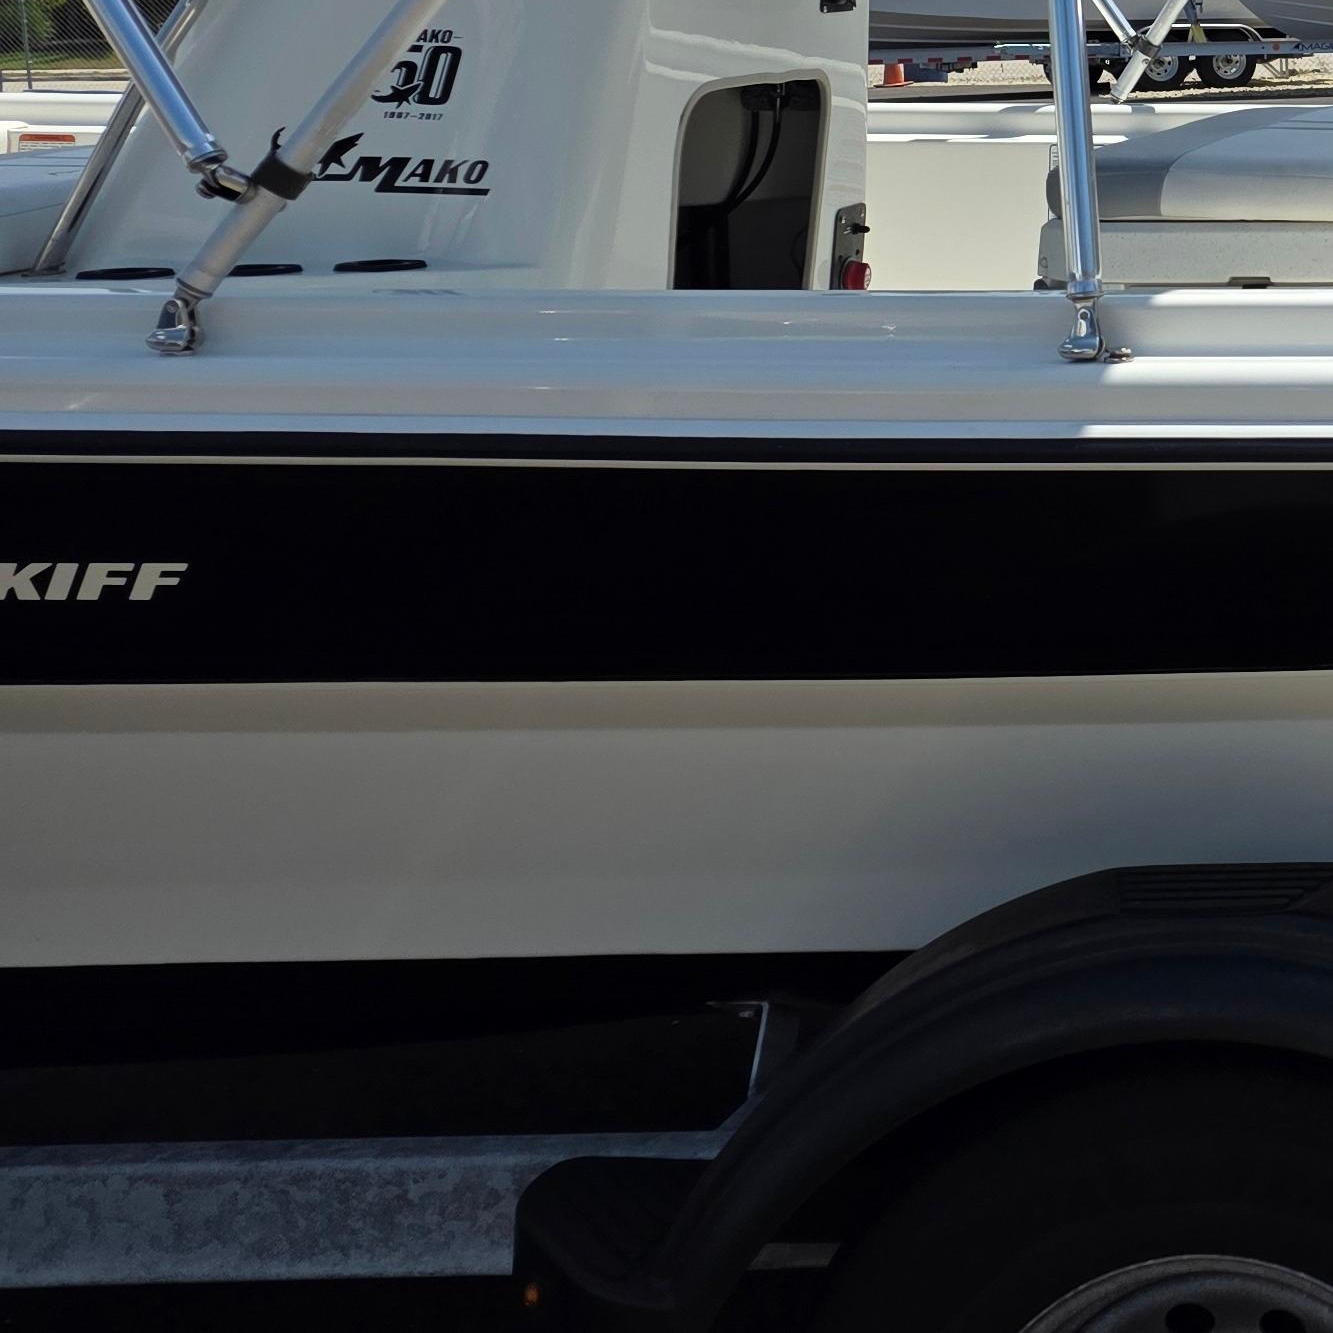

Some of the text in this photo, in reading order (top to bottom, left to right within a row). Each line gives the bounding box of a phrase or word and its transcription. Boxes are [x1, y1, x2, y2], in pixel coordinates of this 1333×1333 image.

[416, 29, 454, 44] AKO
[345, 156, 491, 196] MAKO
[0, 562, 189, 601] KIFF
